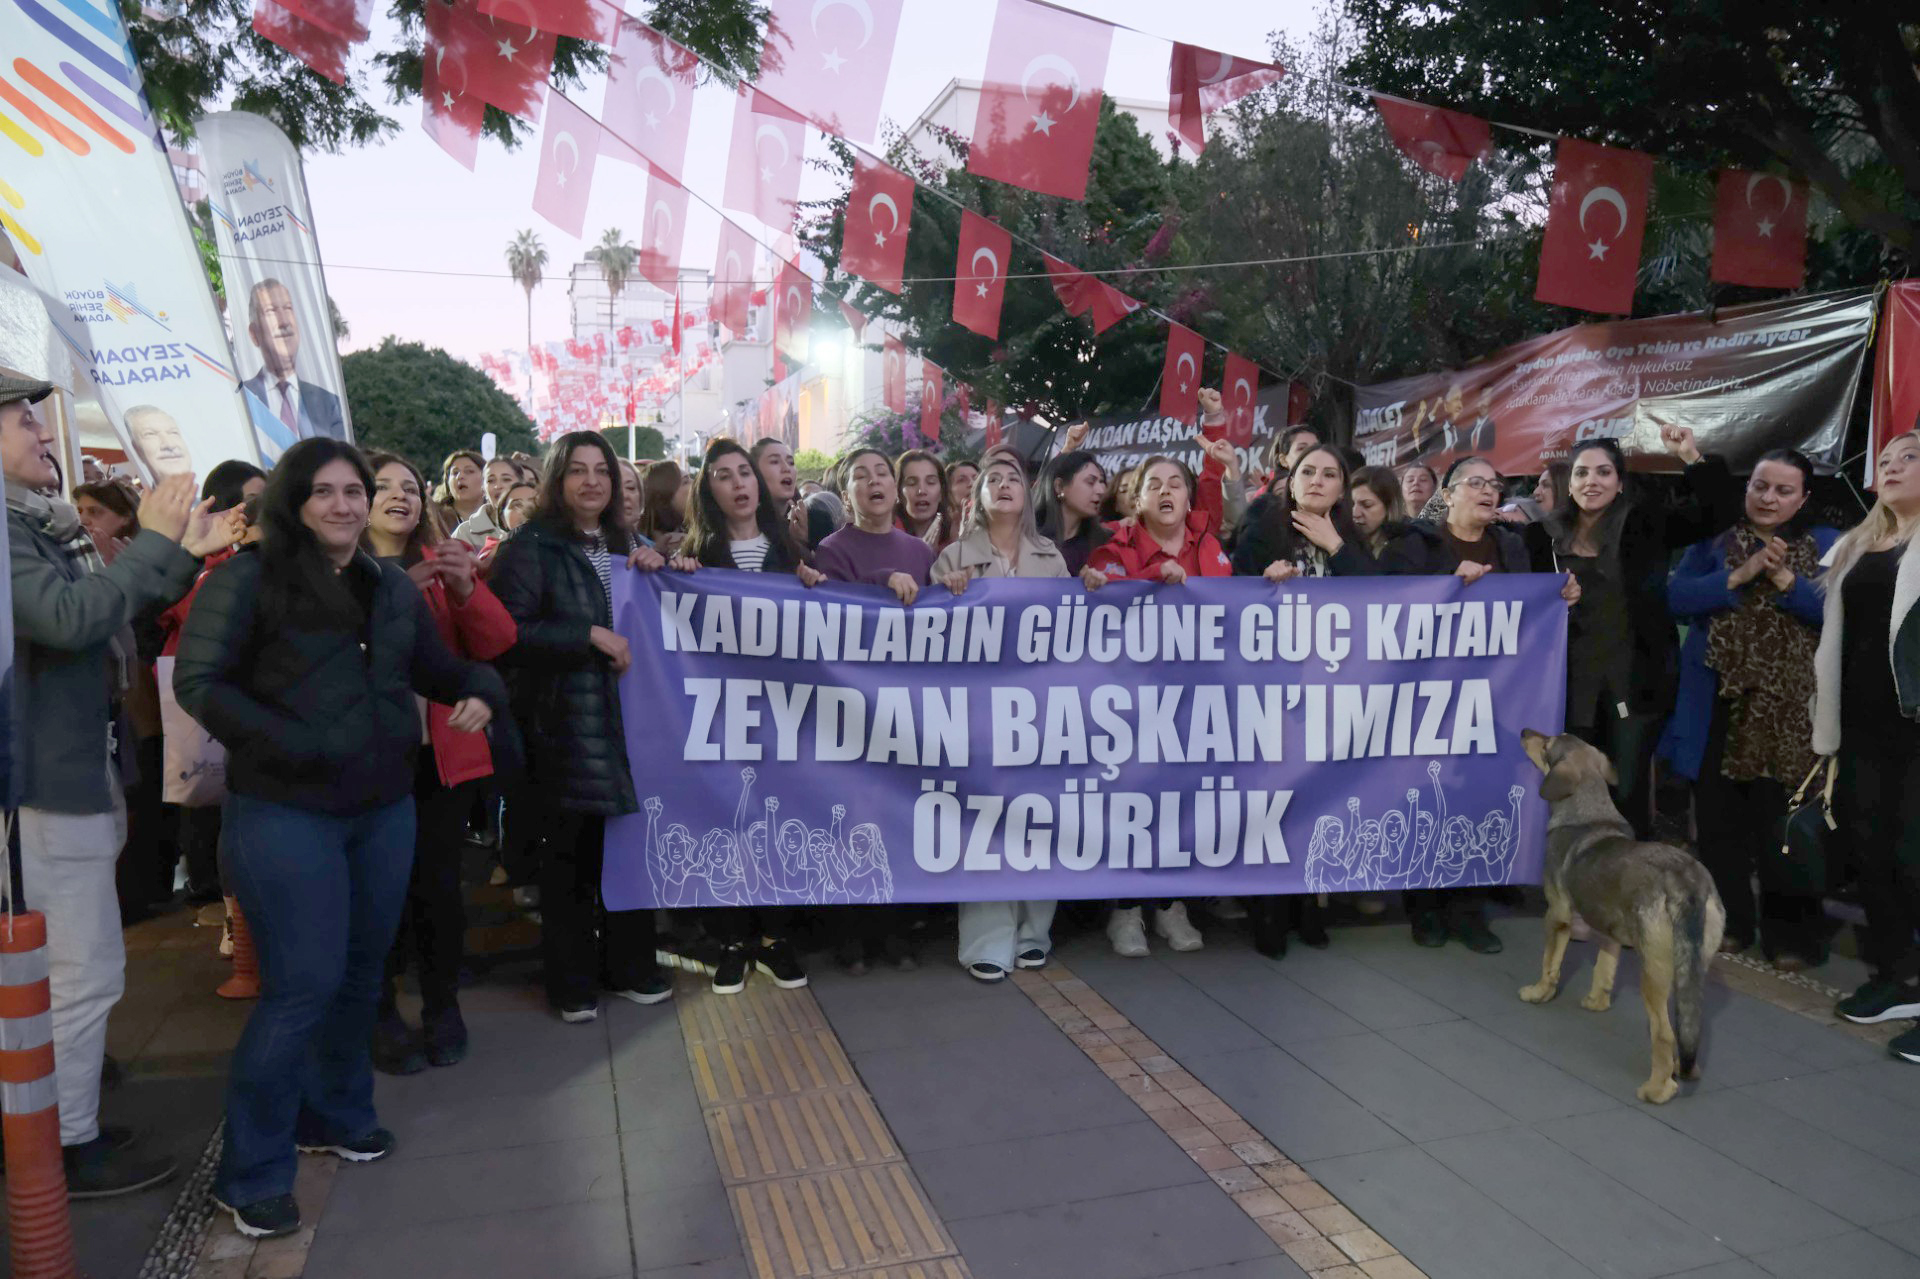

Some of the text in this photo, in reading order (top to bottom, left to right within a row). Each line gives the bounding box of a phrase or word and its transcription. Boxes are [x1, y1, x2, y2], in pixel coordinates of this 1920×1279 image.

[1606, 346, 1635, 361] Oya
[1637, 340, 1681, 356] Tekin
[1682, 340, 1703, 352] ve
[1704, 332, 1753, 350] Kadir
[1754, 328, 1812, 347] Aydar
[1626, 359, 1693, 376] hukuksuz
[1355, 400, 1407, 437] ADALET
[1539, 449, 1568, 459] ADANA
[660, 591, 1523, 673] KADINLARIN GÜCÜNE GÜÇ KATAN
[683, 677, 1498, 780] ZEYDAN BAŞKAN'IMIZA
[913, 775, 1294, 873] ÖZGÜRLÜK
